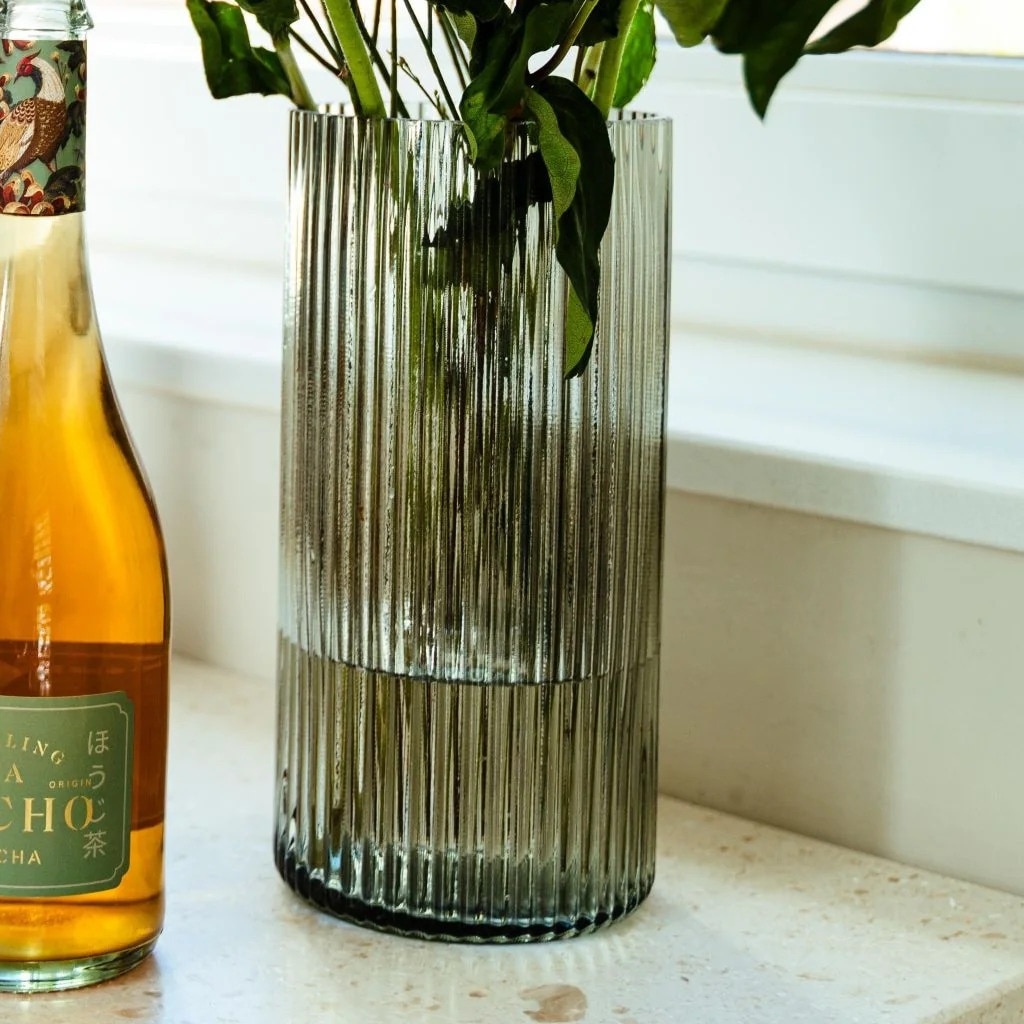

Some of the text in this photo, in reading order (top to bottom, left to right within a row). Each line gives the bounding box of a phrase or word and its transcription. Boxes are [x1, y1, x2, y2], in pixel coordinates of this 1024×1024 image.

[48, 778, 93, 789] ORIGIN
[83, 730, 110, 859] ほうじ茶
